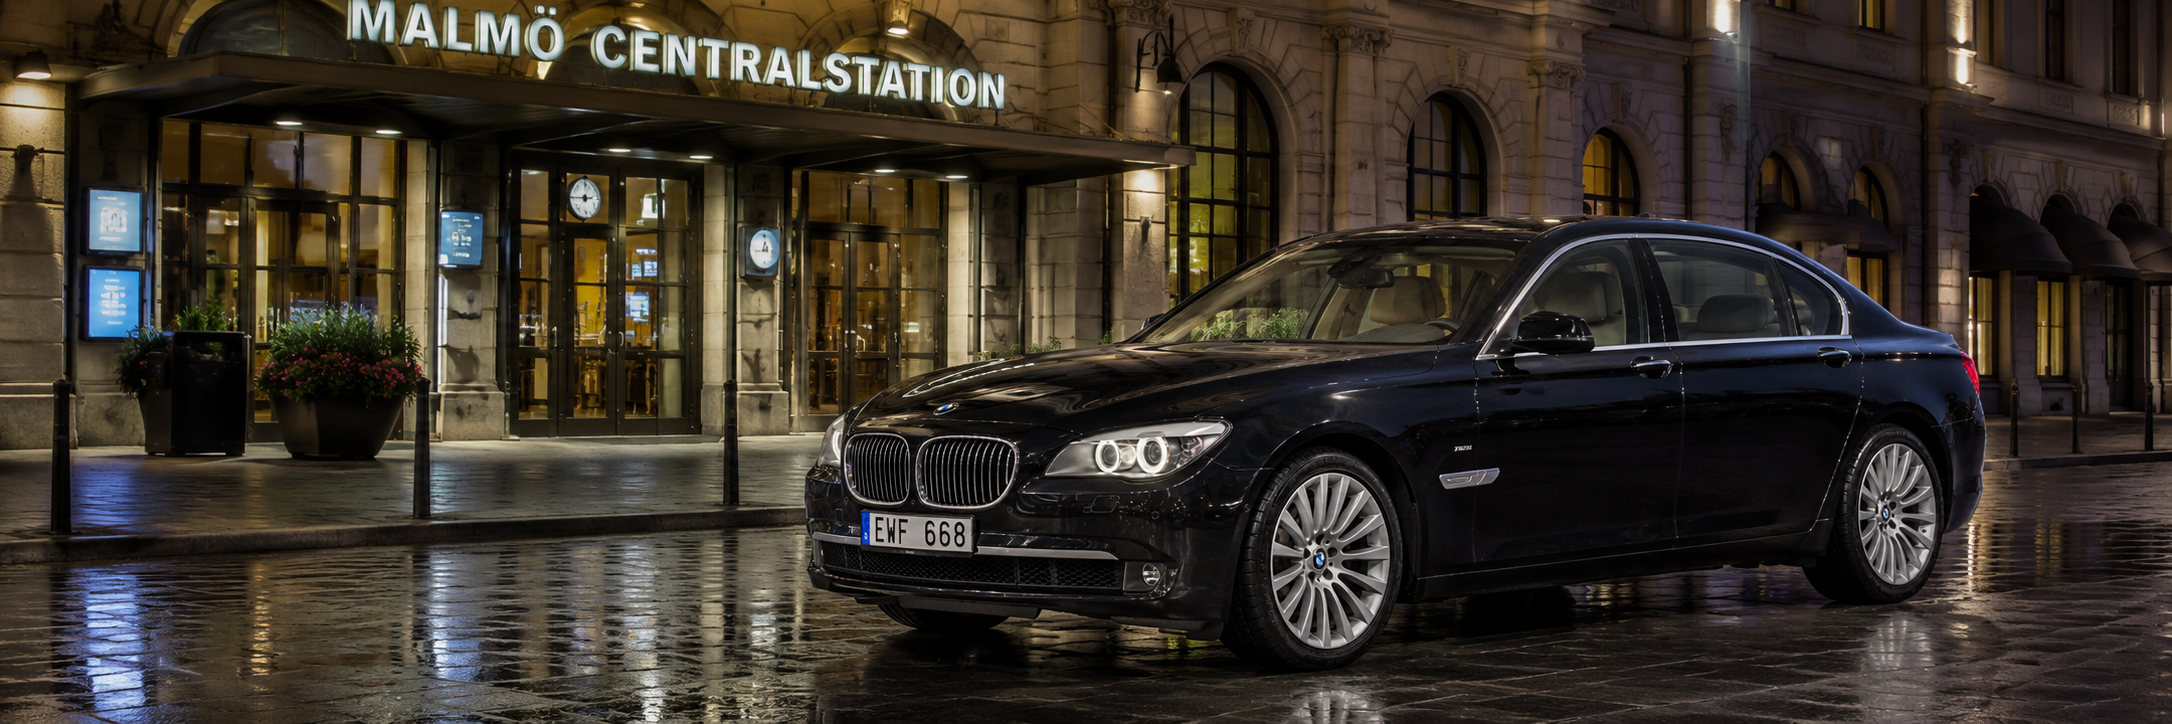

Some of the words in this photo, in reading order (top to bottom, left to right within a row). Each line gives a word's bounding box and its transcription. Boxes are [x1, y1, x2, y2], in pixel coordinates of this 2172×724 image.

[346, 0, 565, 62] MALMÖ
[590, 25, 1005, 110] CENTRALSTATION
[875, 516, 908, 544] EWF
[925, 520, 965, 548] 668
